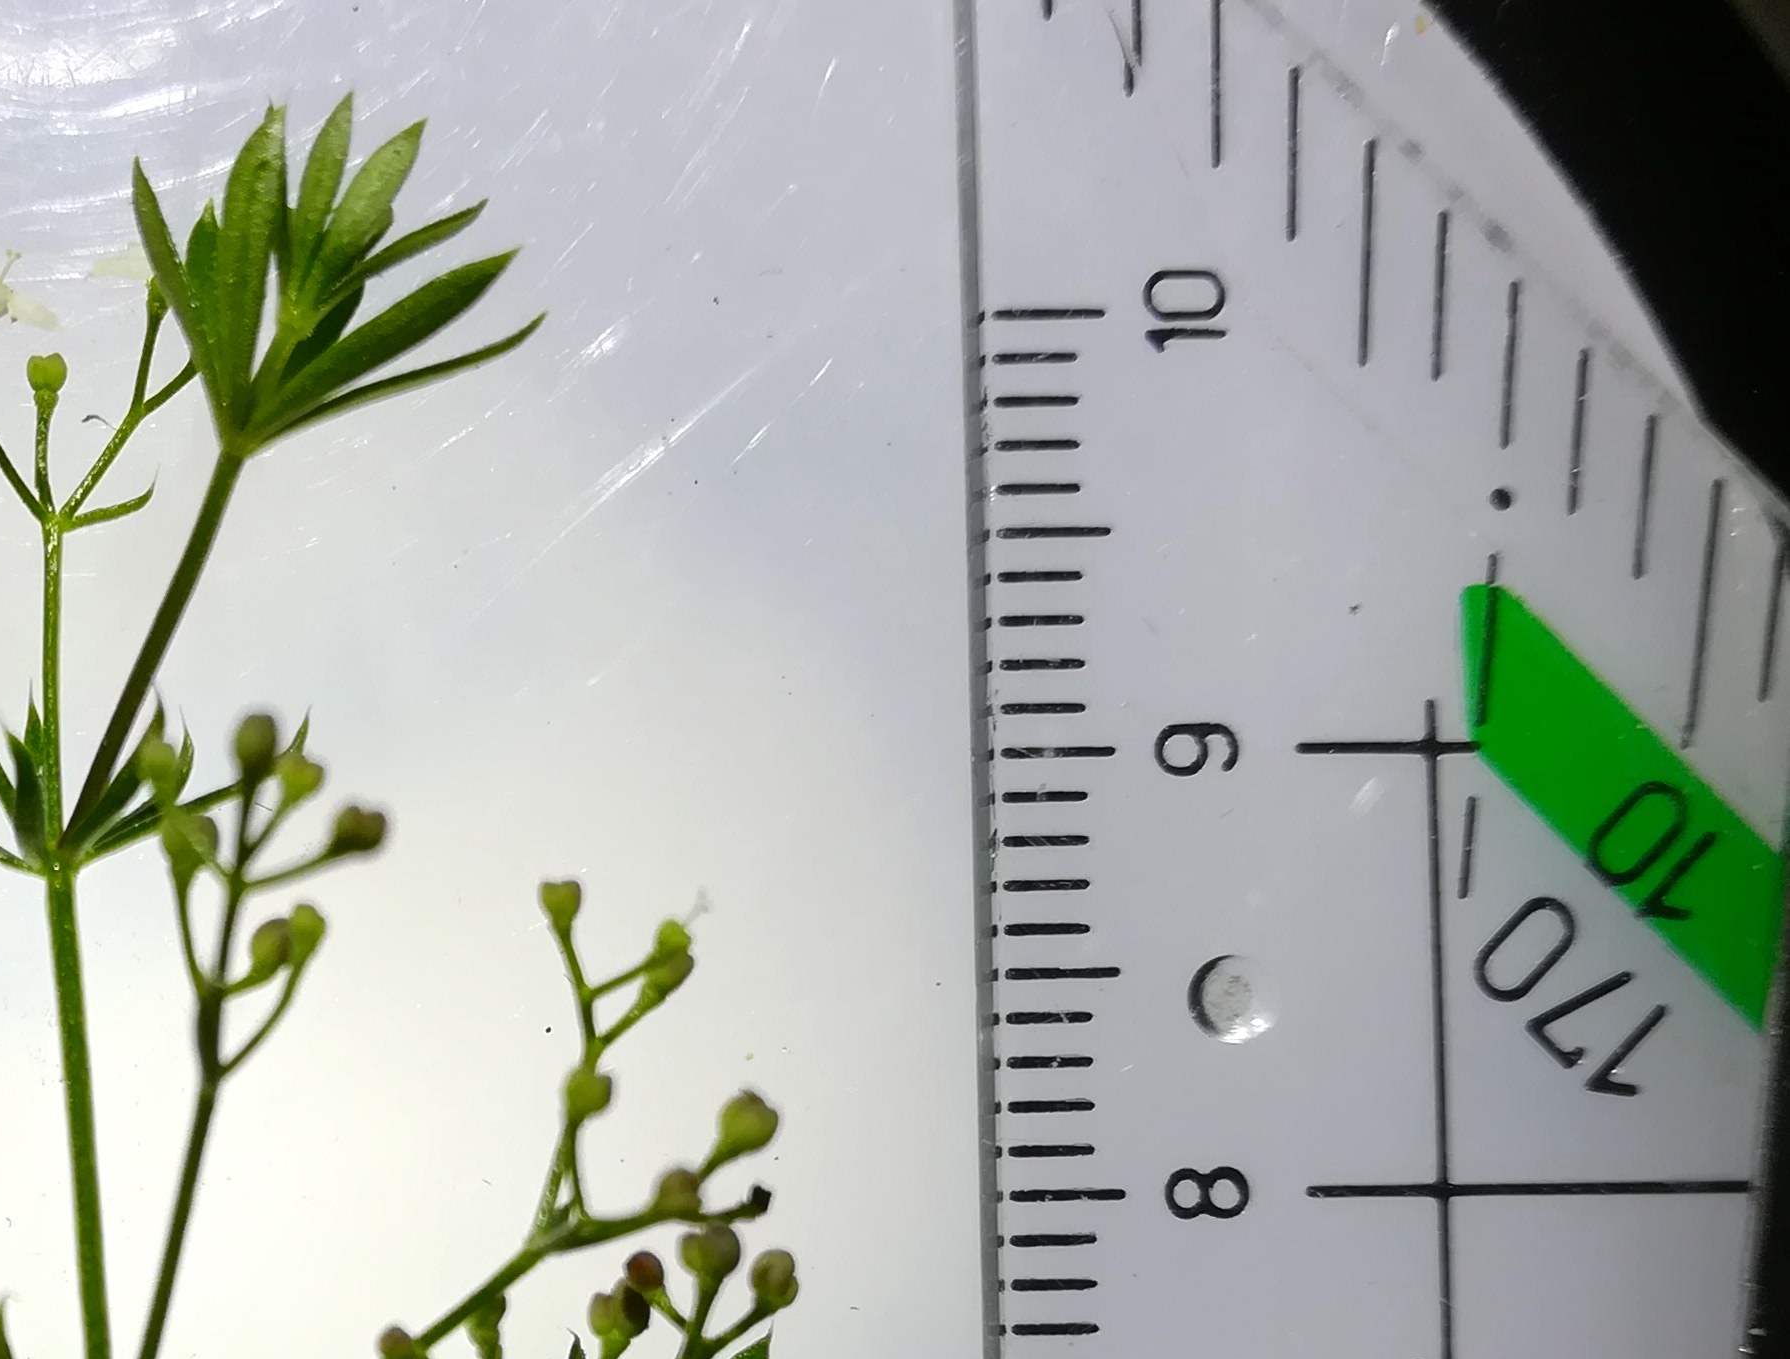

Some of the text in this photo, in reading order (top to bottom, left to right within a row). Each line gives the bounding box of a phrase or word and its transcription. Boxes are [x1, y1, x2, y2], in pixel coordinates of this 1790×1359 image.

[1141, 268, 1228, 353] 10
[1153, 720, 1241, 778] 9
[1584, 779, 1717, 920] 10
[1474, 896, 1667, 1097] 170
[1163, 1164, 1252, 1221] 8
